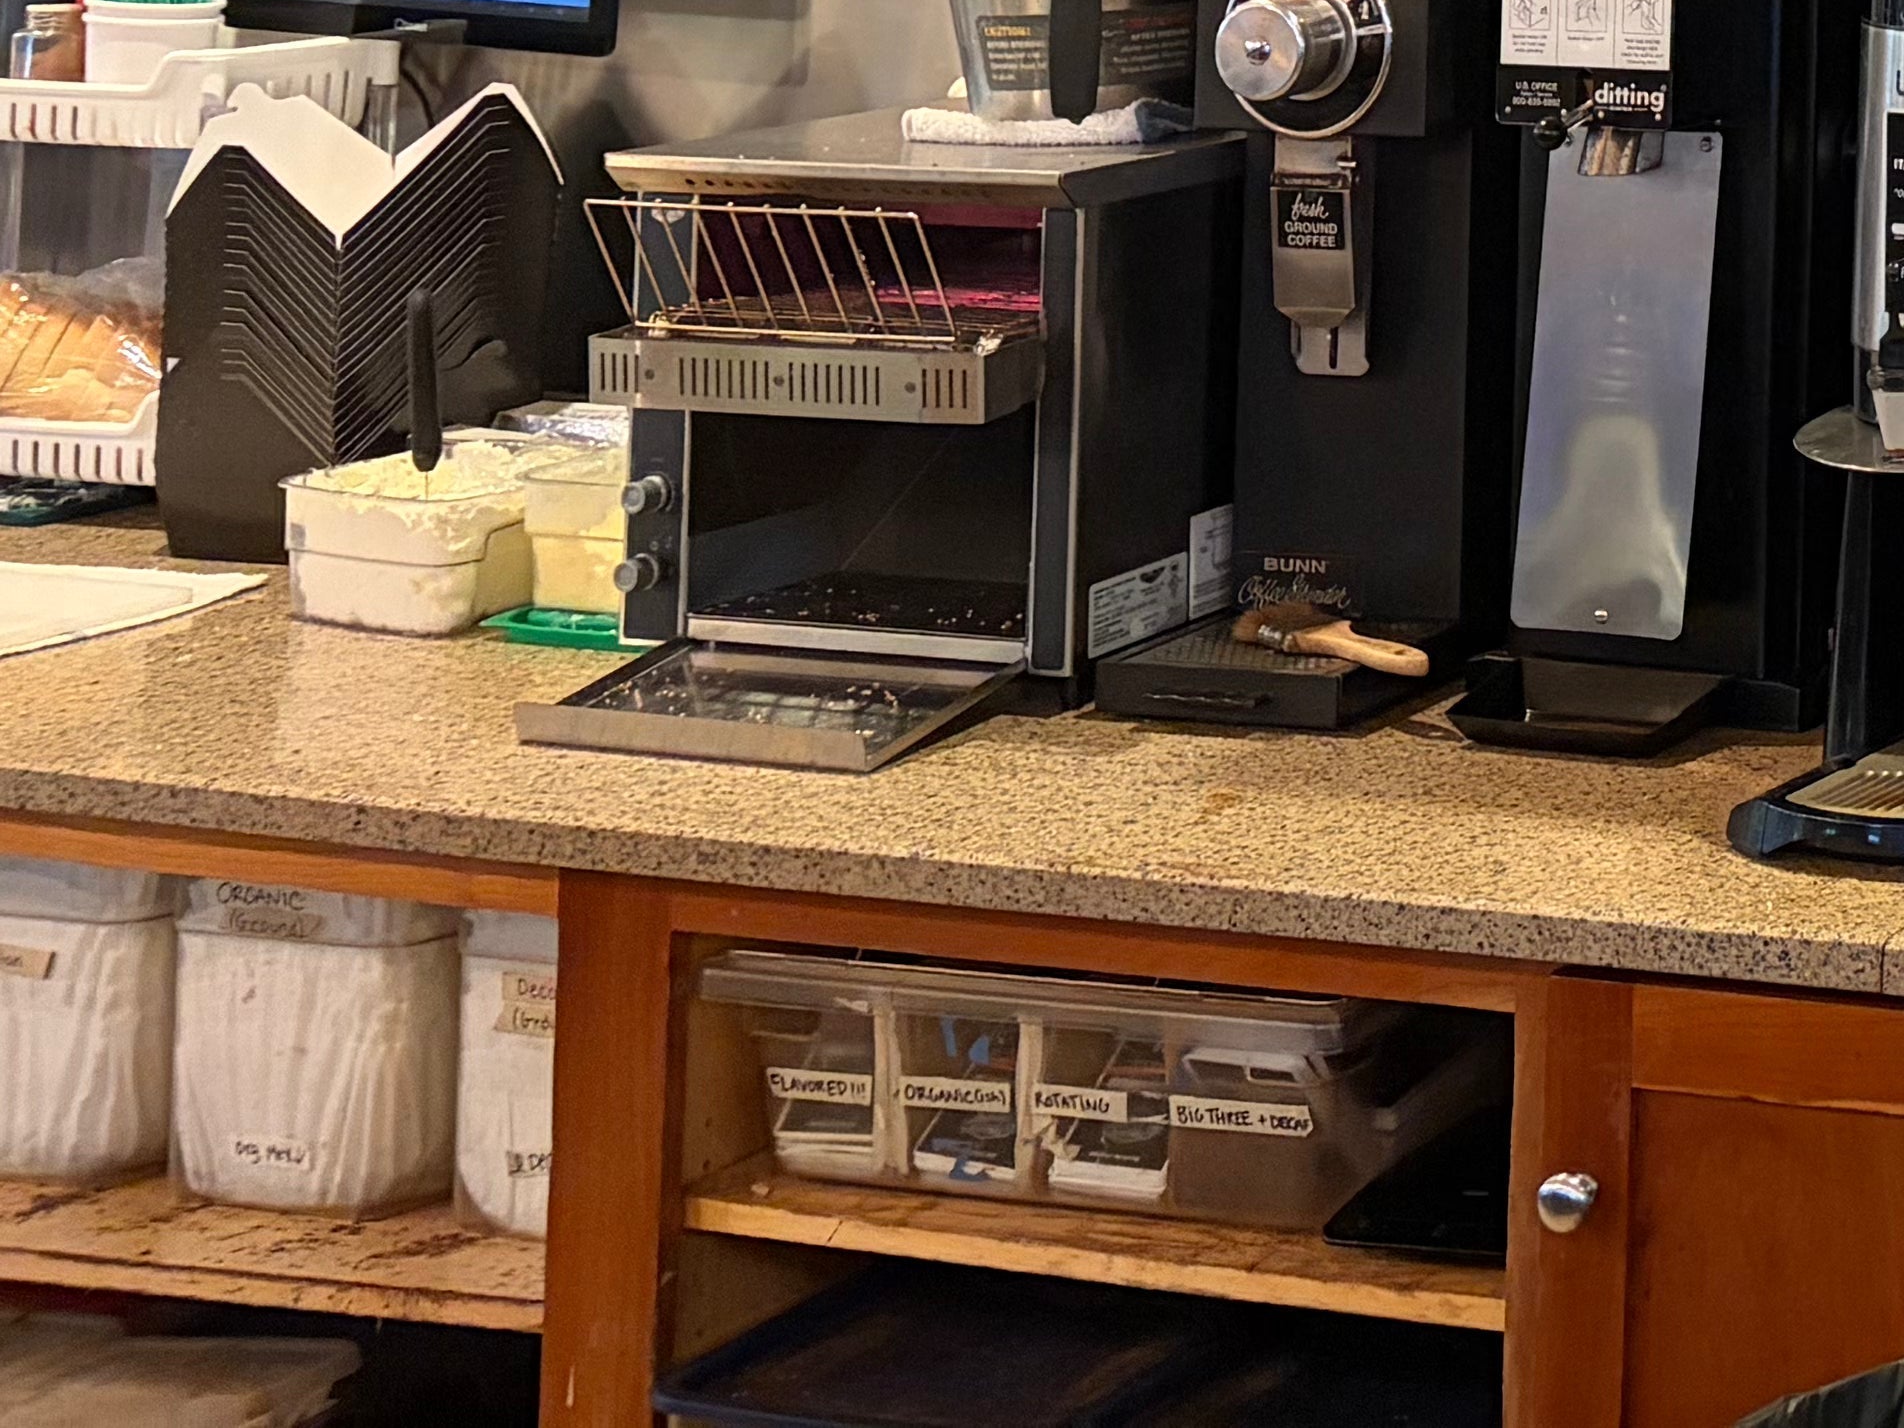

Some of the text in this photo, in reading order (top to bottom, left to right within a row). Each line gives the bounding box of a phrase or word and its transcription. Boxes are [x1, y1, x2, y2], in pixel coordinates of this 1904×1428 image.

[1594, 82, 1666, 113] ditting
[1290, 192, 1330, 221] fresh
[1283, 220, 1338, 235] GROUND
[1286, 233, 1337, 248] COFFEE
[1034, 1088, 1111, 1115] ROTATING
[1176, 1103, 1254, 1128] BIG THREE
